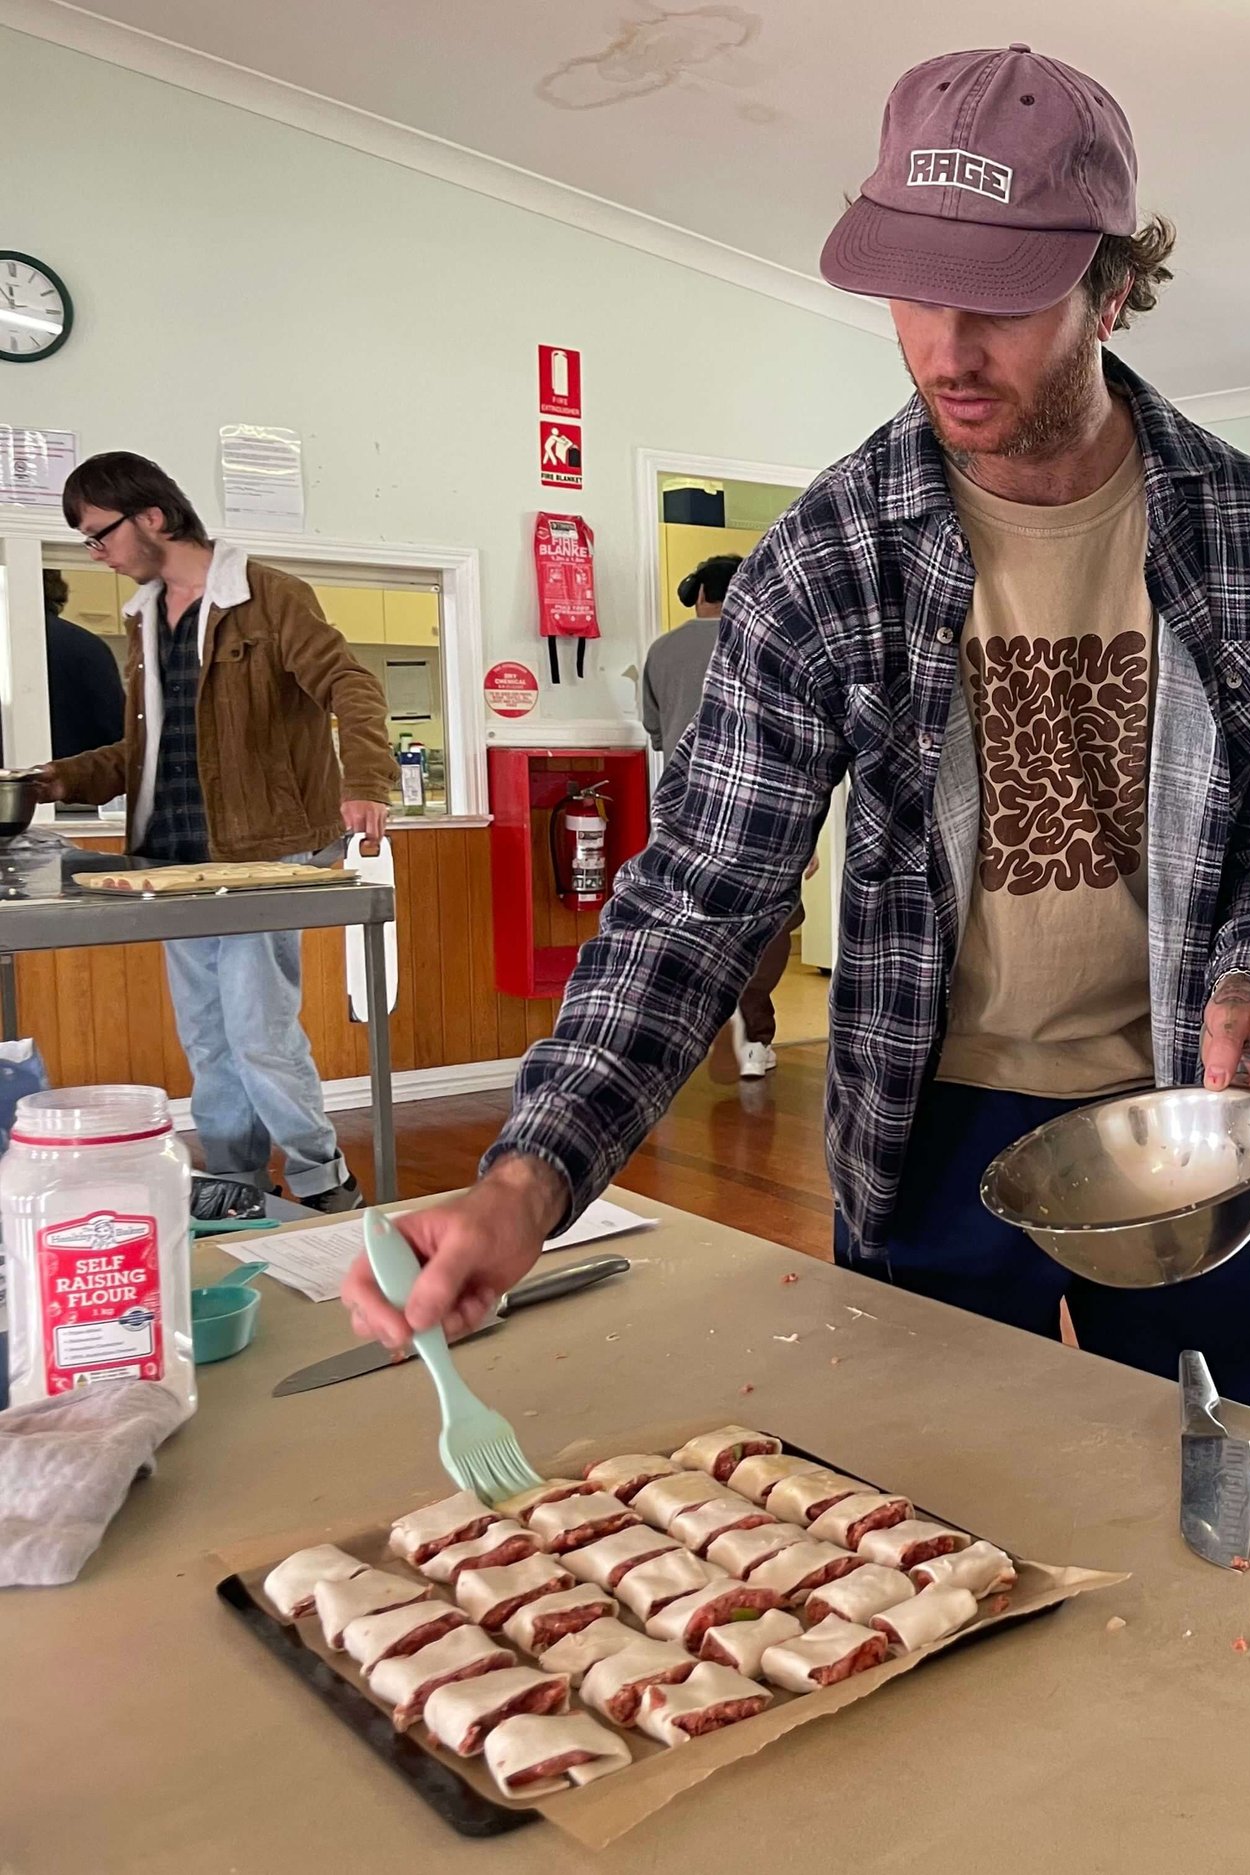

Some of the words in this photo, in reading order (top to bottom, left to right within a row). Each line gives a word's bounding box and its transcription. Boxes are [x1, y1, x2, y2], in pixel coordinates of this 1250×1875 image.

[909, 151, 1011, 201] RAGE
[541, 472, 554, 480] FIRE
[556, 474, 582, 483] BLANKET
[552, 537, 579, 547] FIRE
[76, 1255, 125, 1274] SELF
[56, 1269, 147, 1293] RAISING
[67, 1286, 138, 1308] FLOUR
